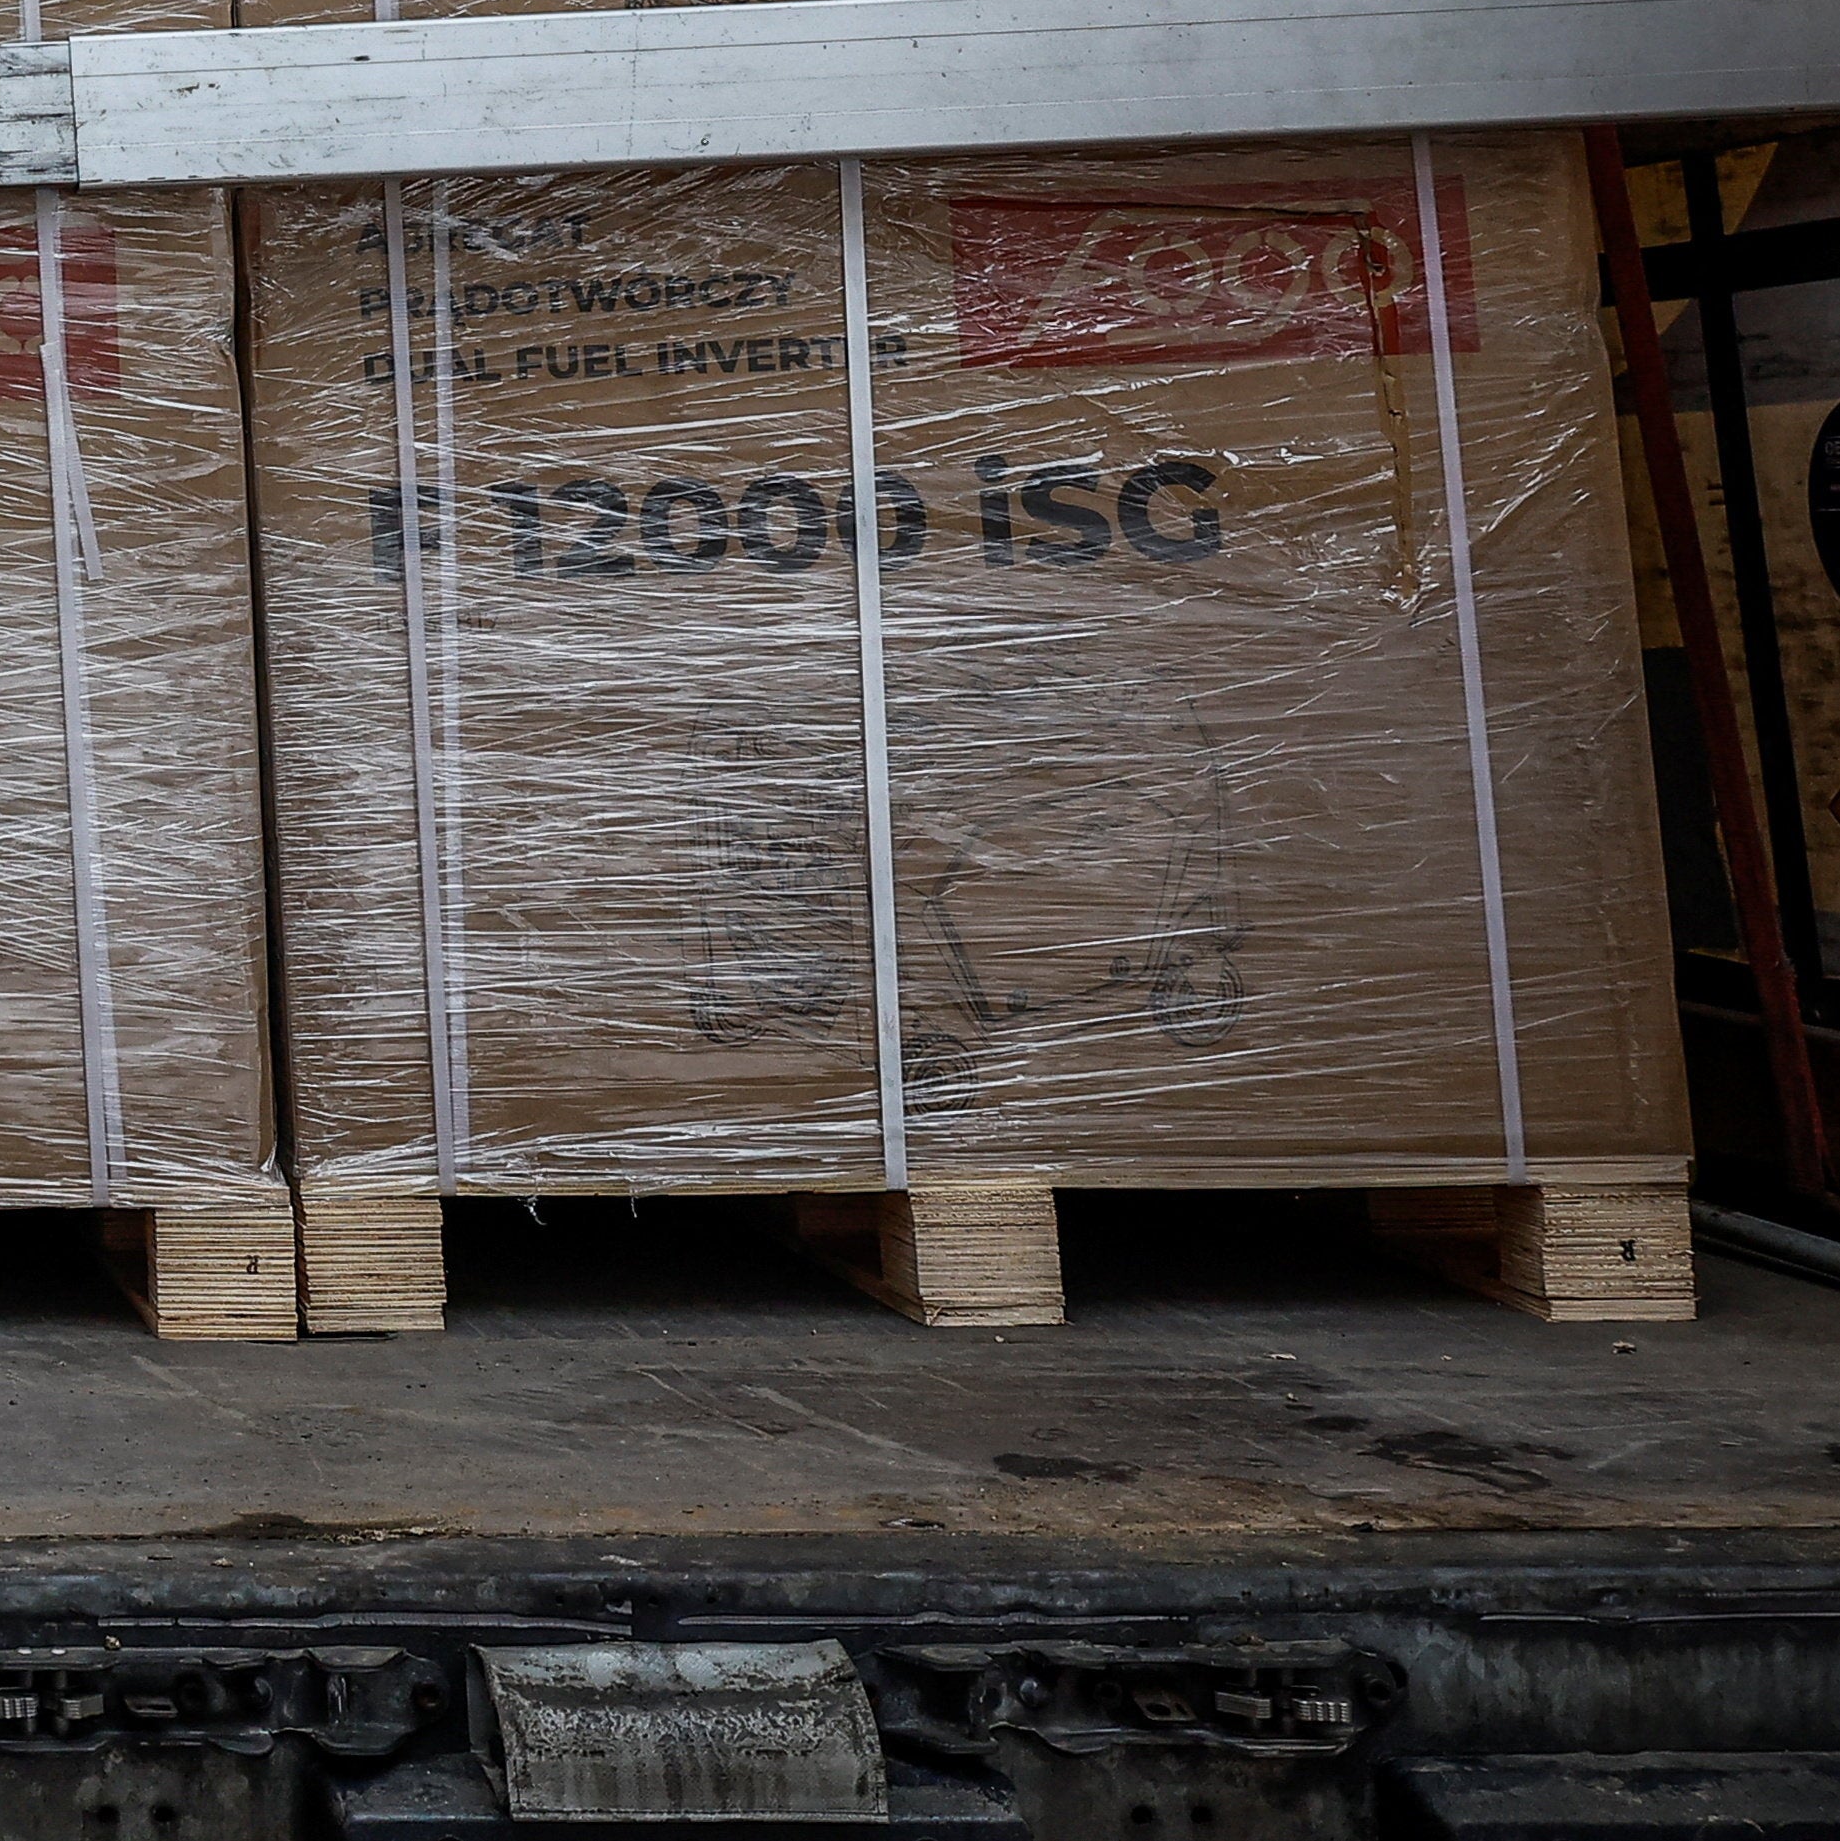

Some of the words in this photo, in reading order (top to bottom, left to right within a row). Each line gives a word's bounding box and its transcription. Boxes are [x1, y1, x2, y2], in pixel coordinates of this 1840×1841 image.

[520, 341, 634, 380] FUEL
[491, 470, 928, 580] 12000
[975, 452, 1223, 565] iSG
